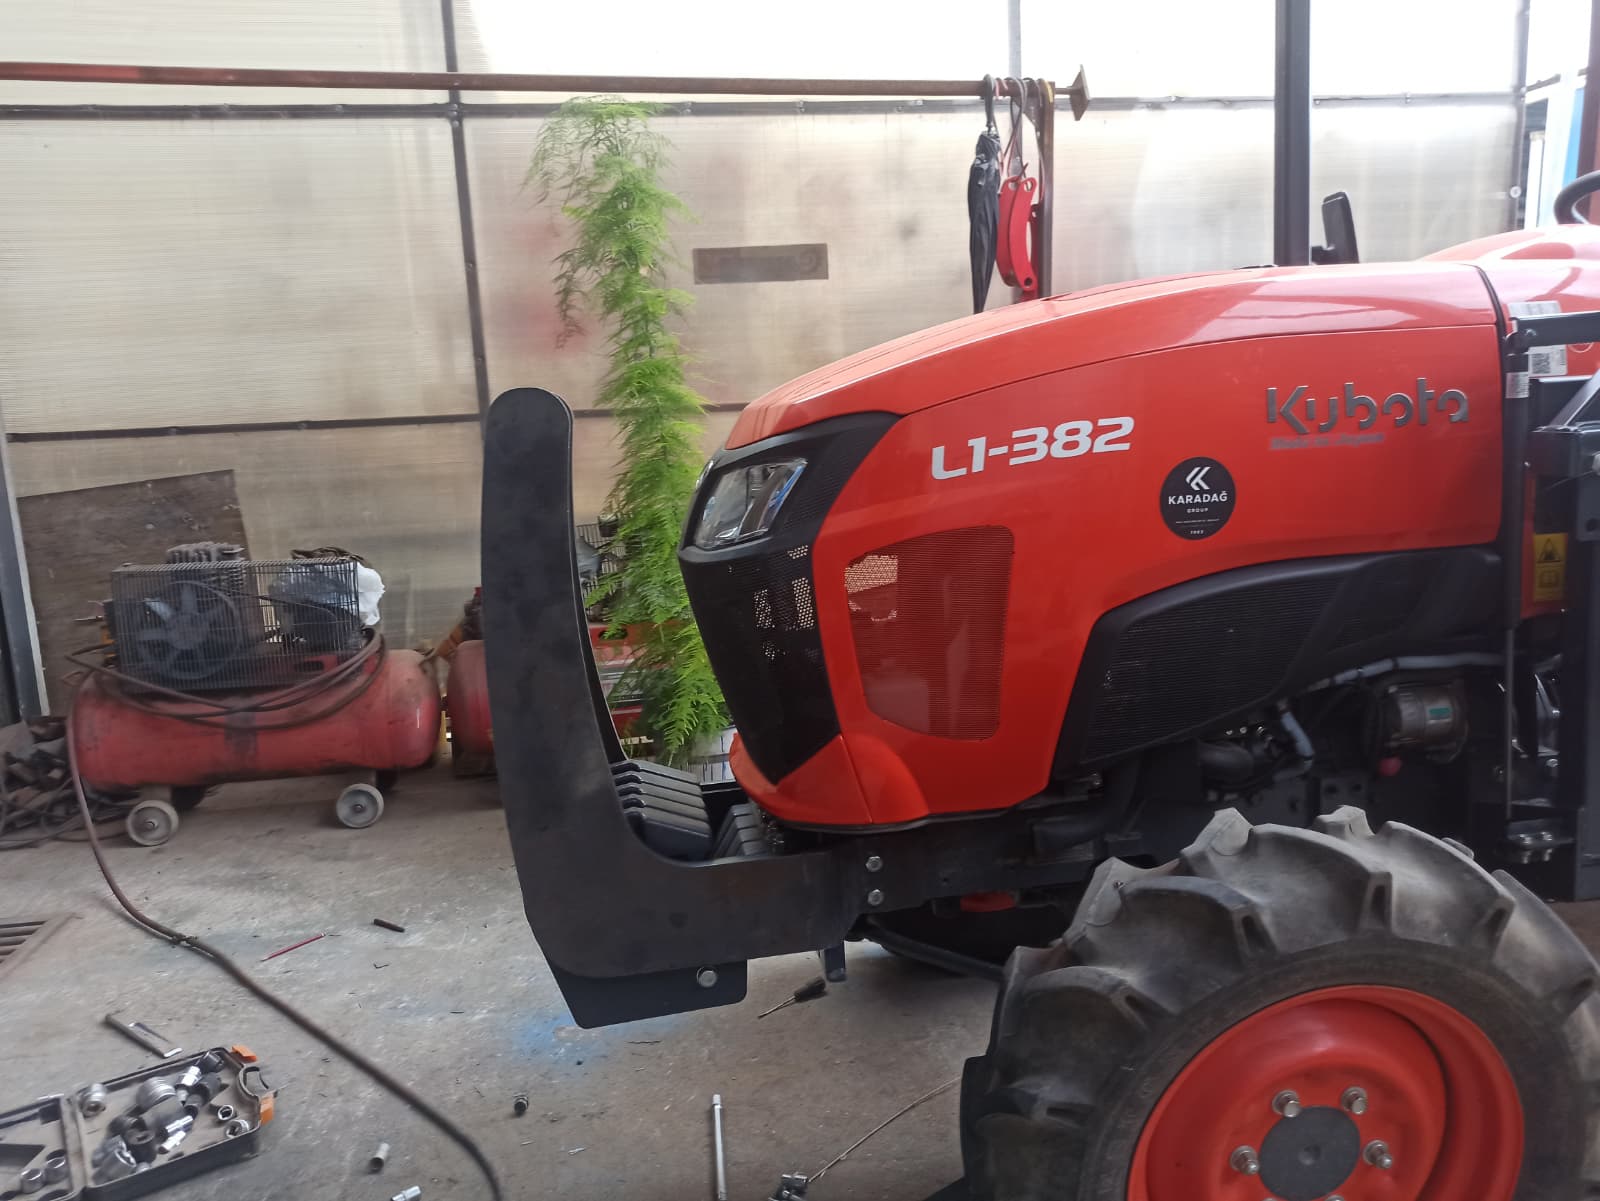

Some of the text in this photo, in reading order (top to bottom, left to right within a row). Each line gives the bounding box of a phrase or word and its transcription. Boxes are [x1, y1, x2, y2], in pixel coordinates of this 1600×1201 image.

[1266, 377, 1470, 434] Kubota
[931, 416, 1135, 480] L1-382
[1168, 490, 1228, 505] KARADAĞ
